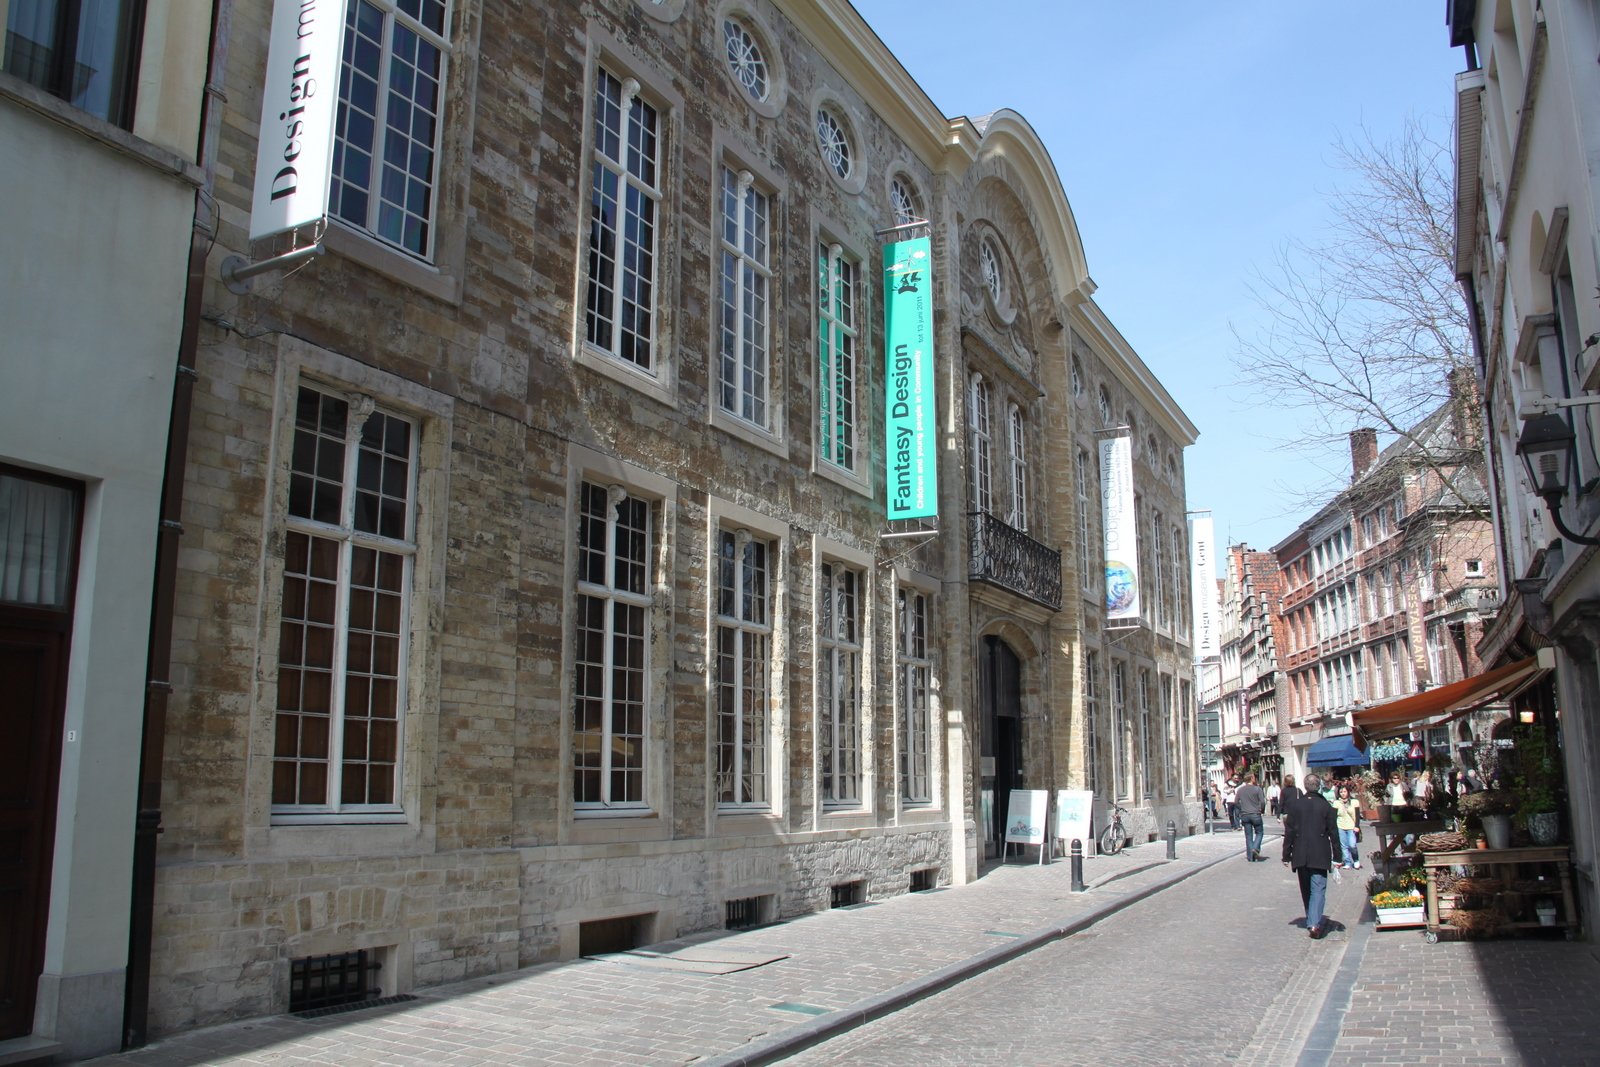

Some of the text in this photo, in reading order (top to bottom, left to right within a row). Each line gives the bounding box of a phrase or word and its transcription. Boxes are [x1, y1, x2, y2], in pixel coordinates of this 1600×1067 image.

[270, 52, 317, 205] Design
[891, 344, 914, 512] Fantasy Design
[914, 350, 925, 509] Children and young people in Community
[1102, 443, 1120, 551] L'Objet Sublime
[1196, 540, 1211, 650] Design museum Gent
[1408, 584, 1427, 671] RESTAURANT
